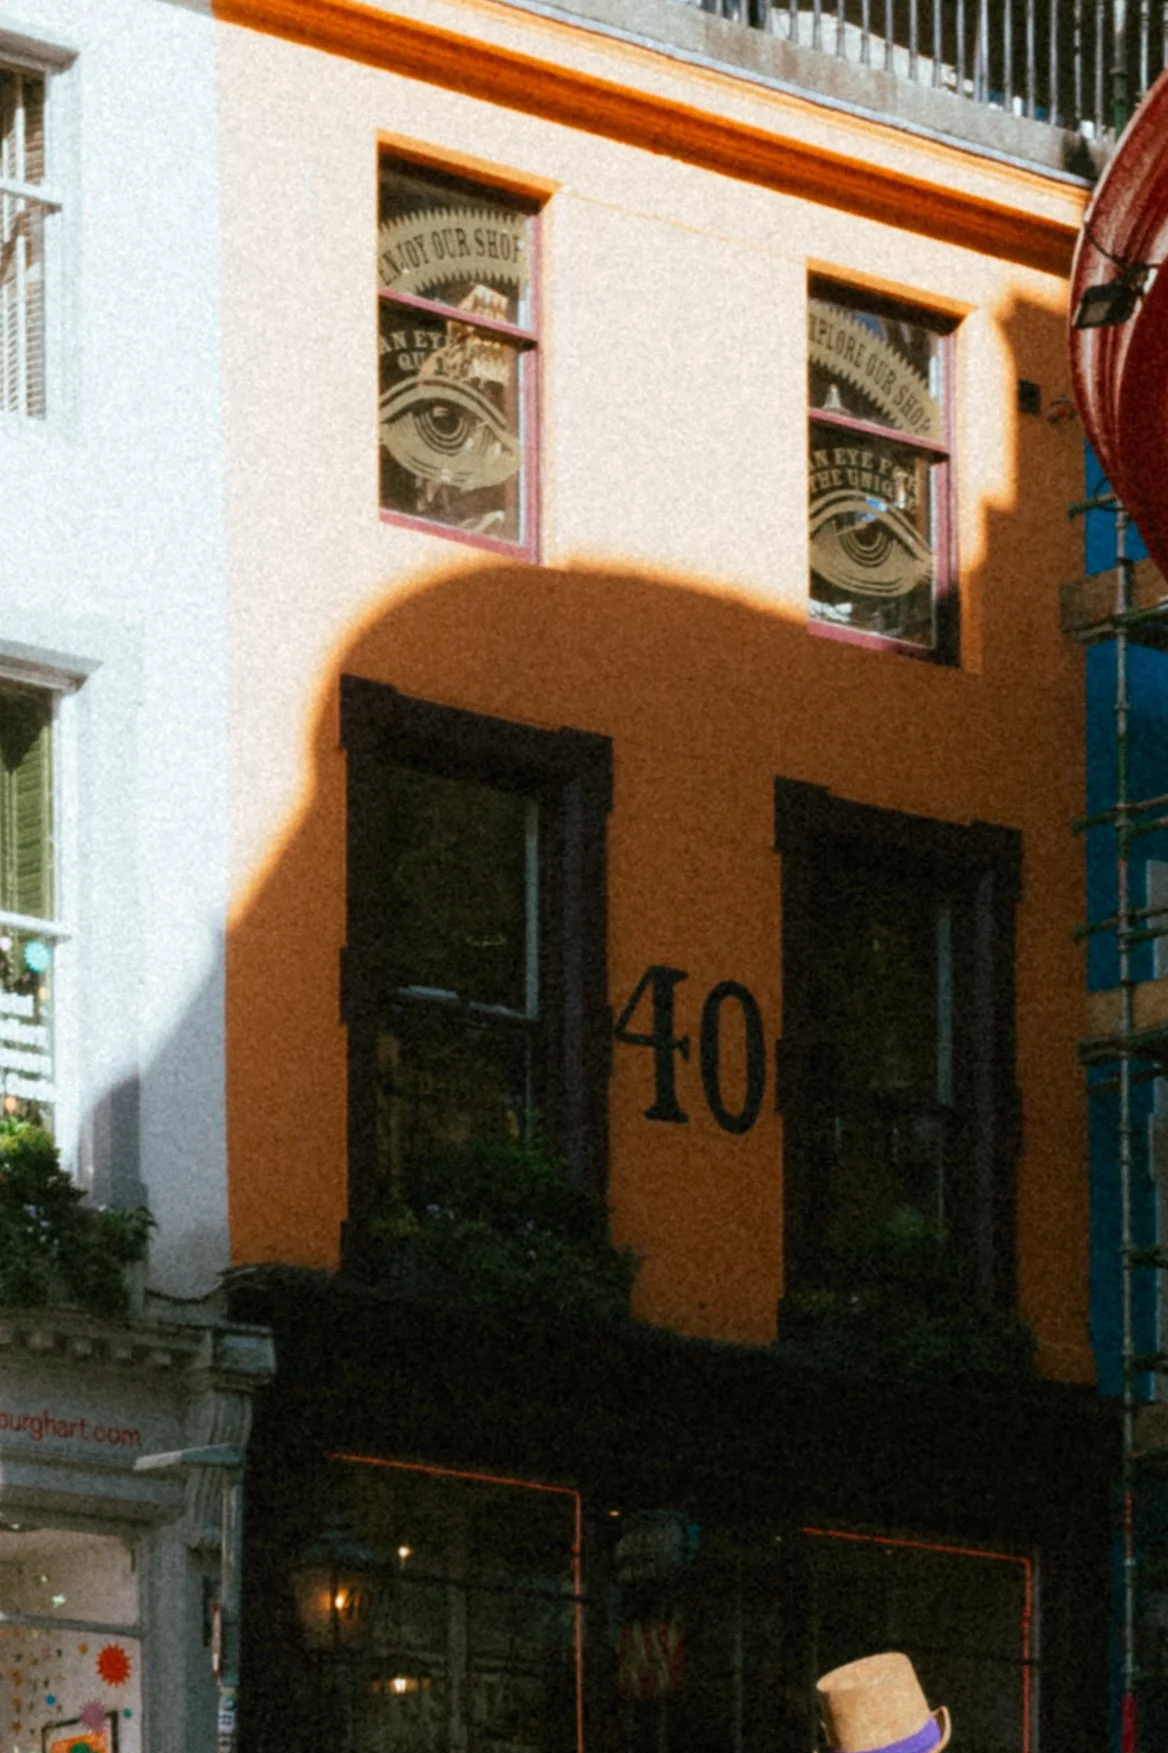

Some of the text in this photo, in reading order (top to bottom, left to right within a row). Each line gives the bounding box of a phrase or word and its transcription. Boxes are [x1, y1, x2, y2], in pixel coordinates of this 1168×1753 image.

[431, 227, 470, 260] OUR
[866, 353, 897, 396] OUR
[833, 448, 874, 469] EYE
[614, 964, 766, 1135] 40
